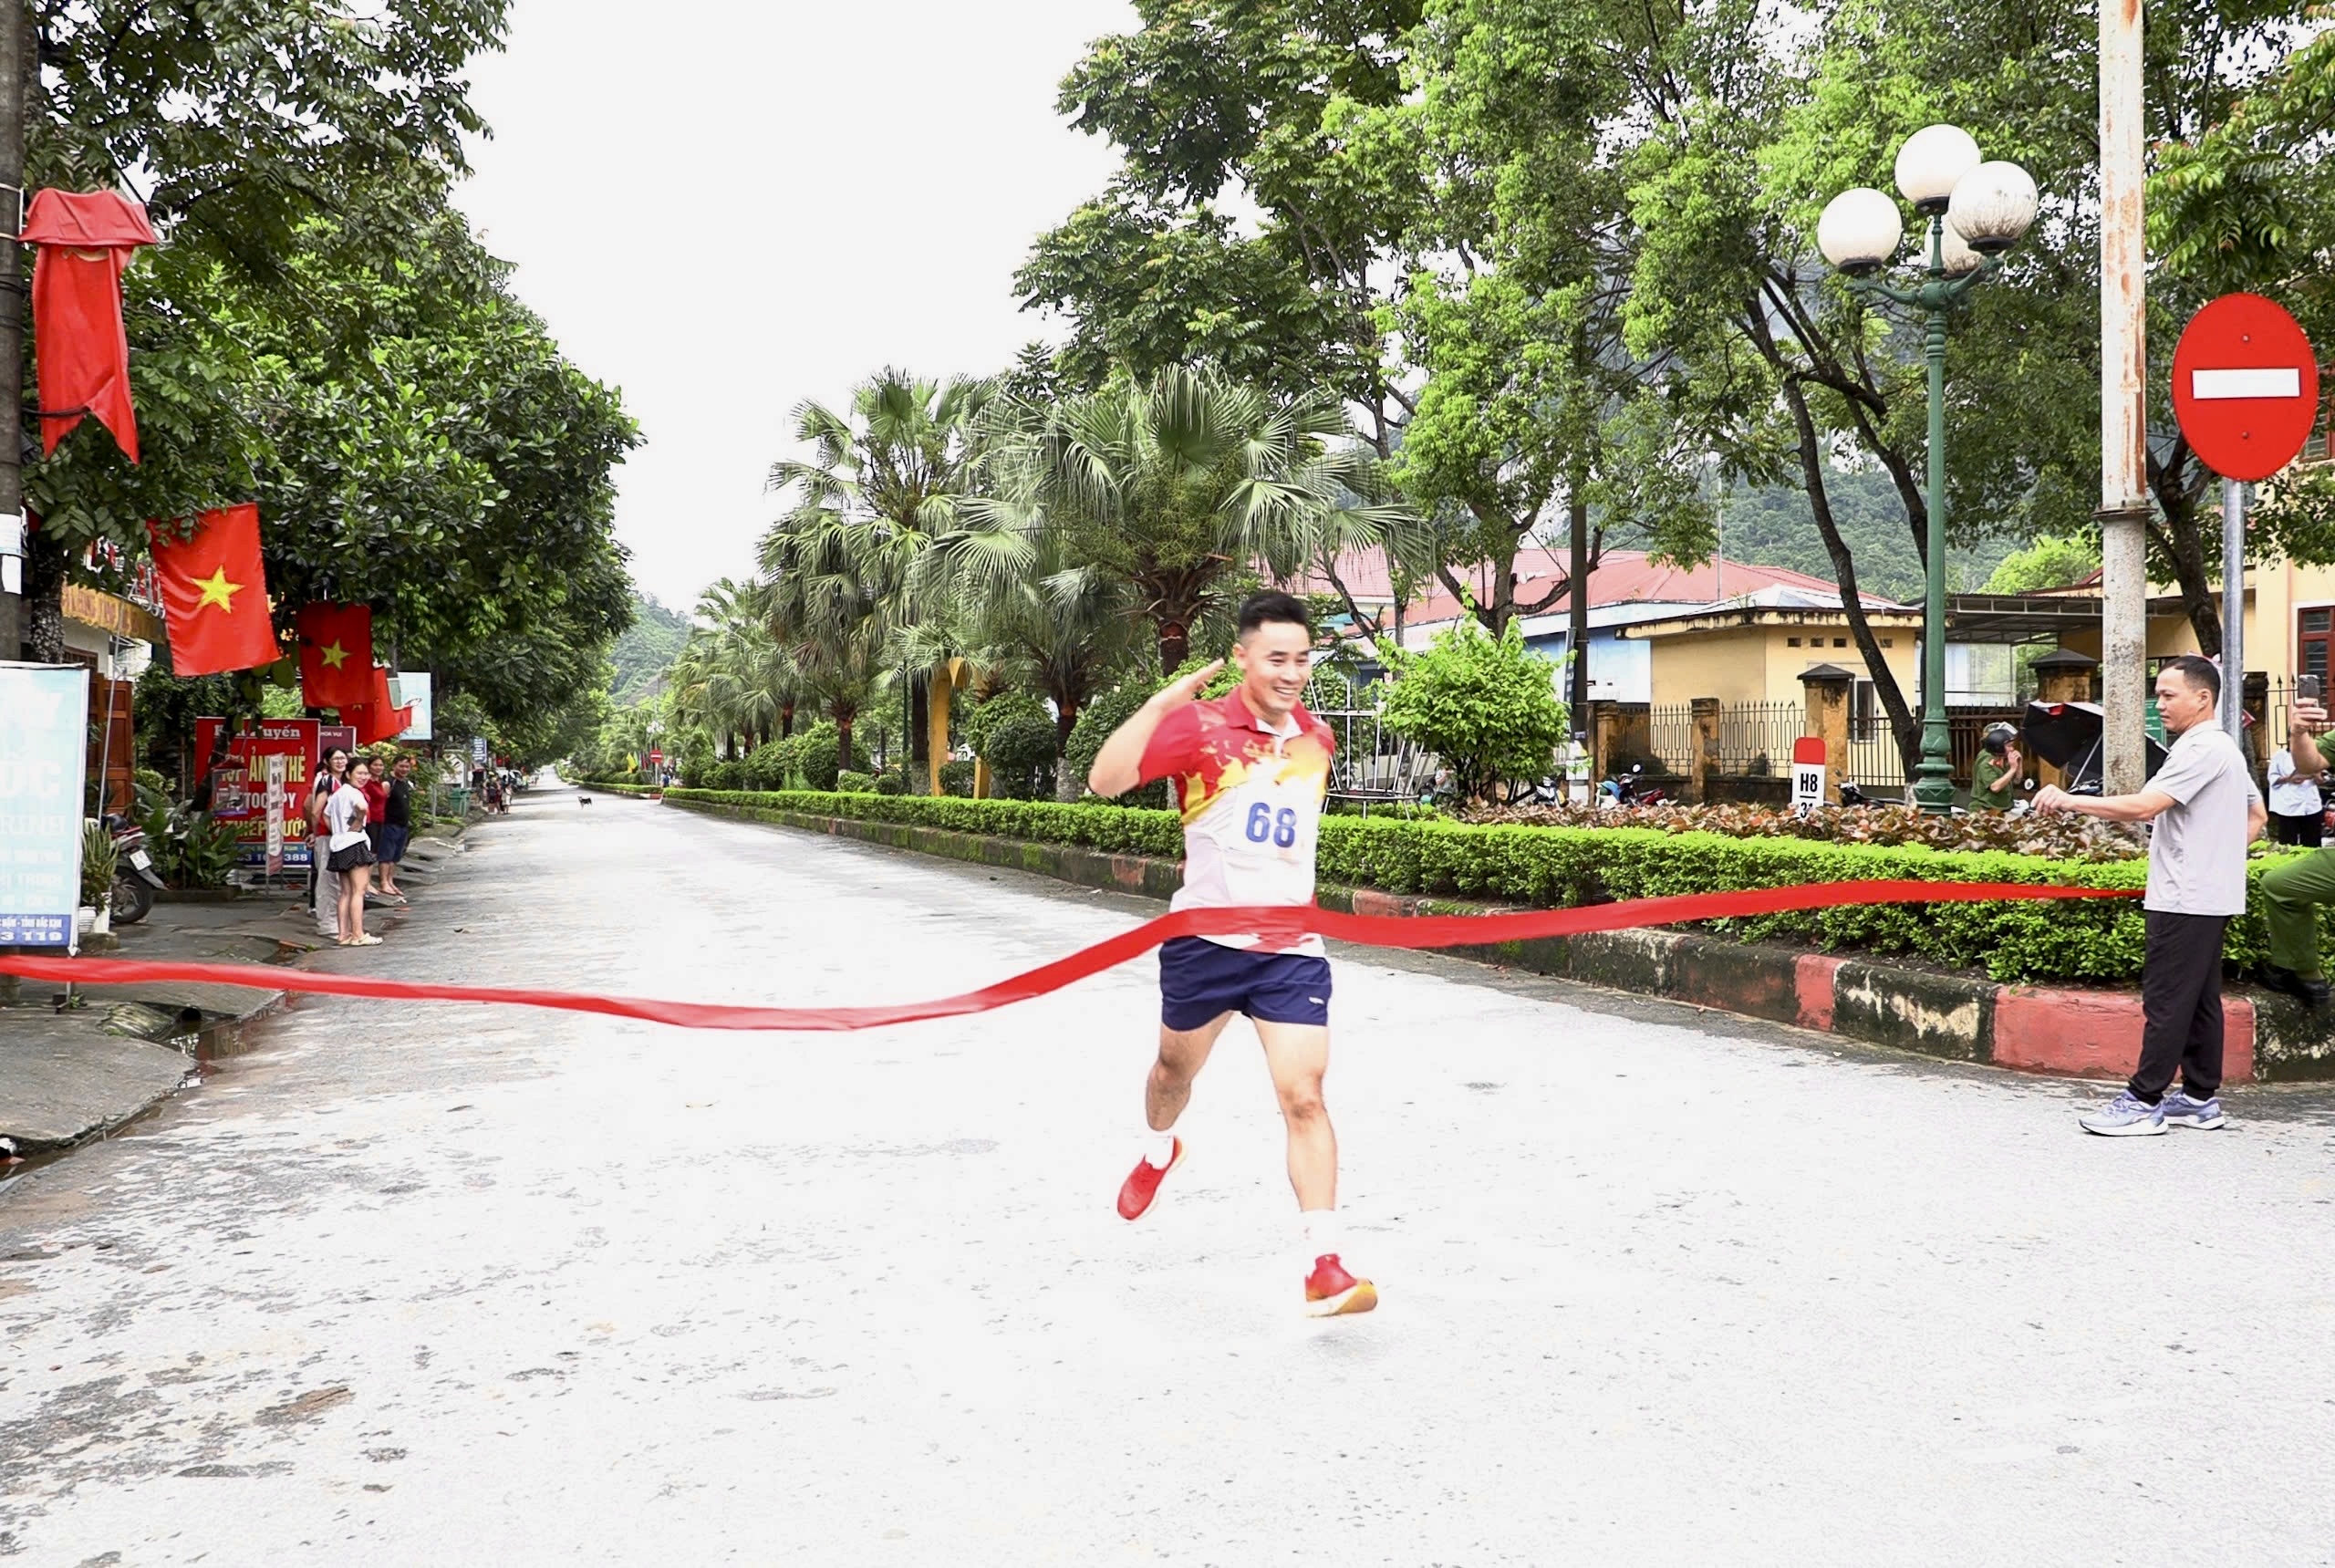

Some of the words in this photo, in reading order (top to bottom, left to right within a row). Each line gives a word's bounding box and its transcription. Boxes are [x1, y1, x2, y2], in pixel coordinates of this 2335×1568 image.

[250, 724, 301, 740] uyến
[248, 745, 272, 782] ẢN
[1801, 774, 1818, 792] H8
[1801, 802, 1813, 818] 3
[1246, 802, 1297, 848] 68
[285, 853, 308, 861] 388
